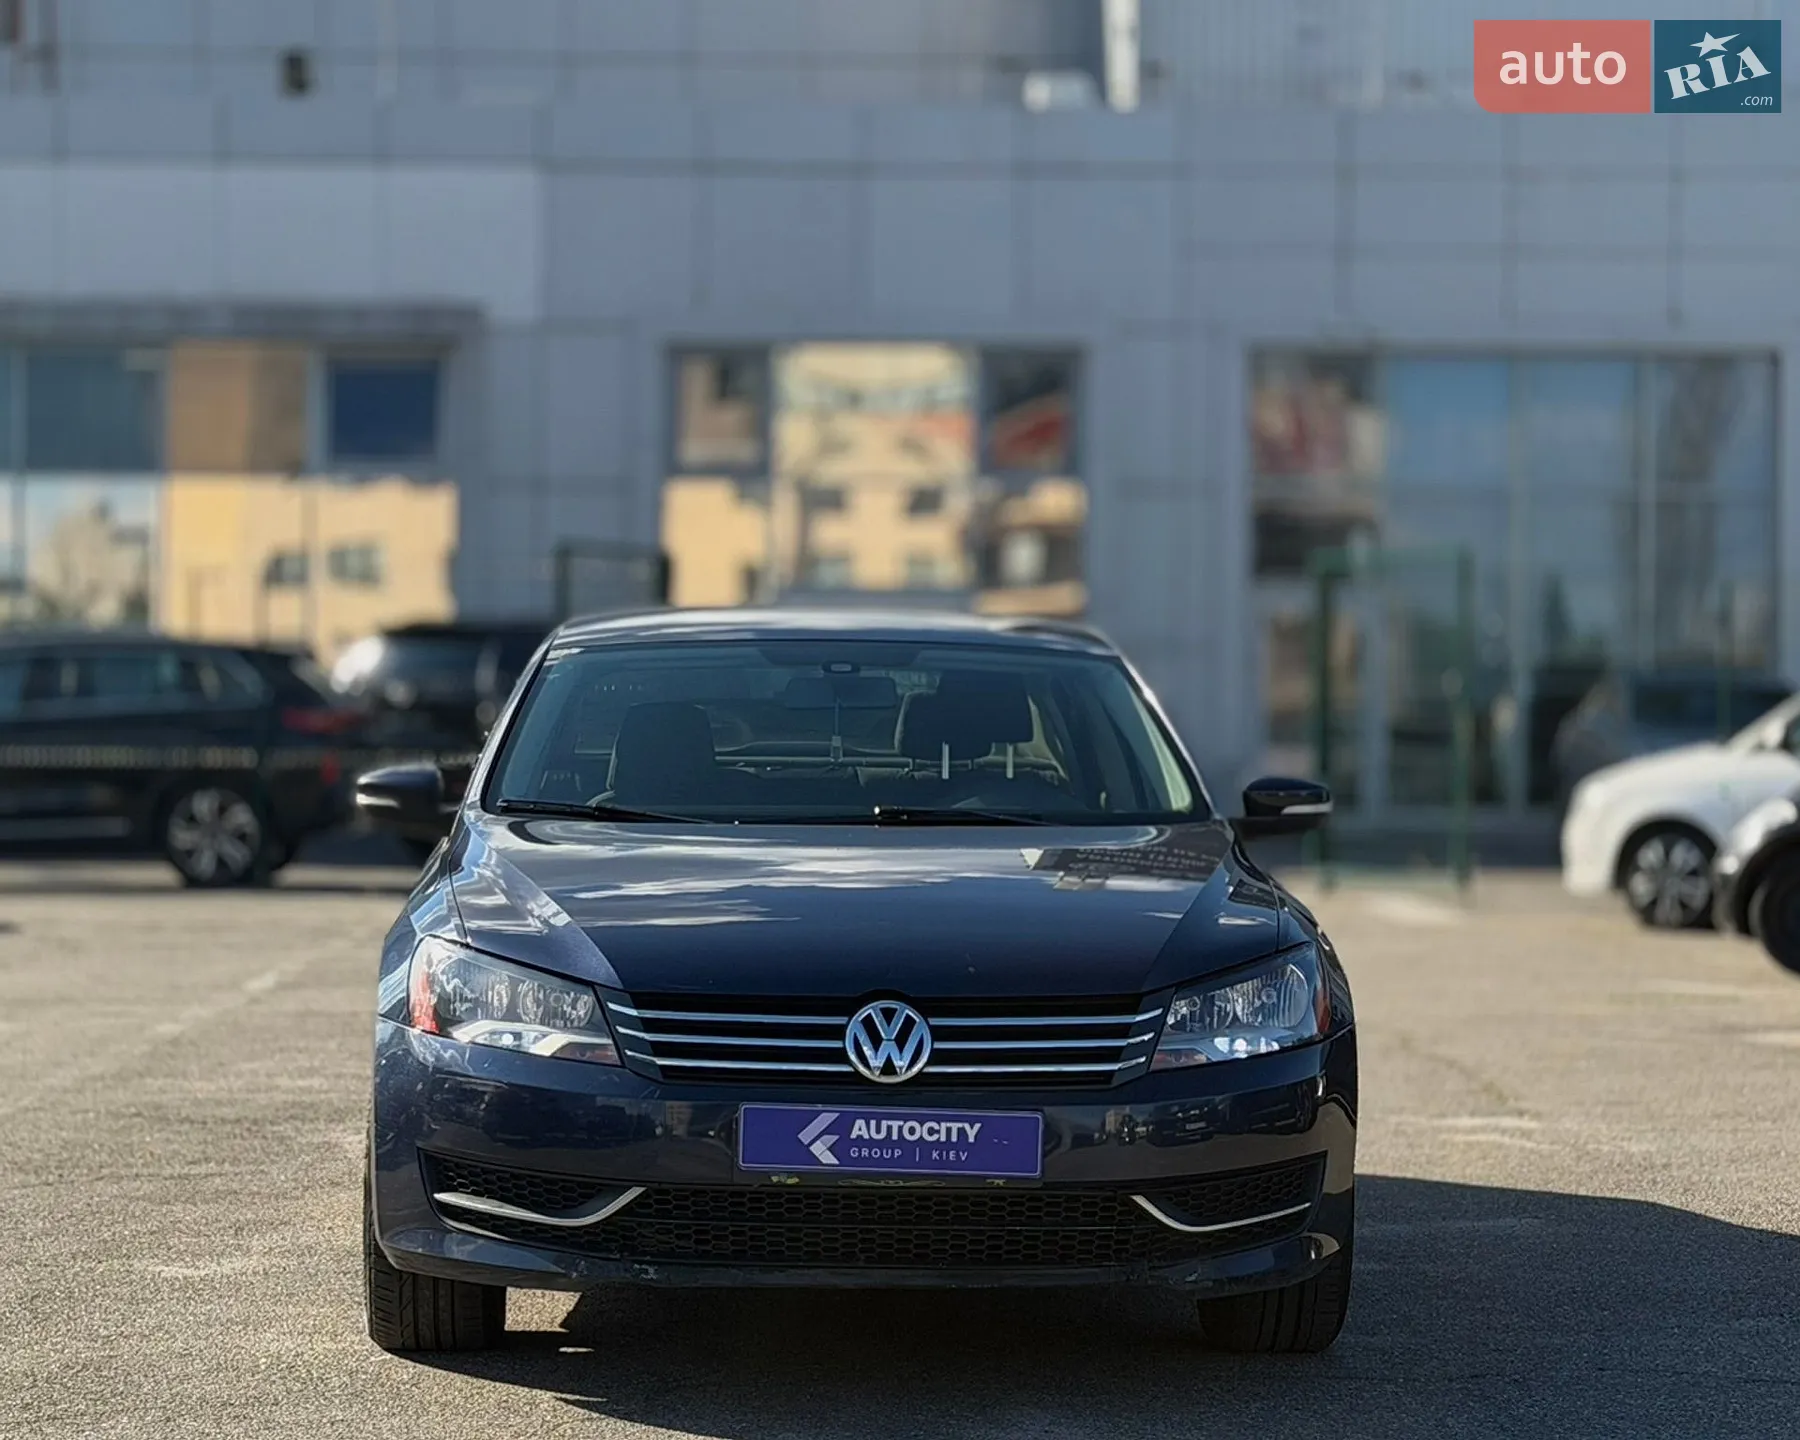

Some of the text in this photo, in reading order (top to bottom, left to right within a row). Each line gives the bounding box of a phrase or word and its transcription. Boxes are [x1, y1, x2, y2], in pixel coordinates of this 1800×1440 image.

[850, 1119, 982, 1143] AUTOCITY
[850, 1147, 903, 1159] GROUP
[932, 1150, 969, 1162] KIEV
